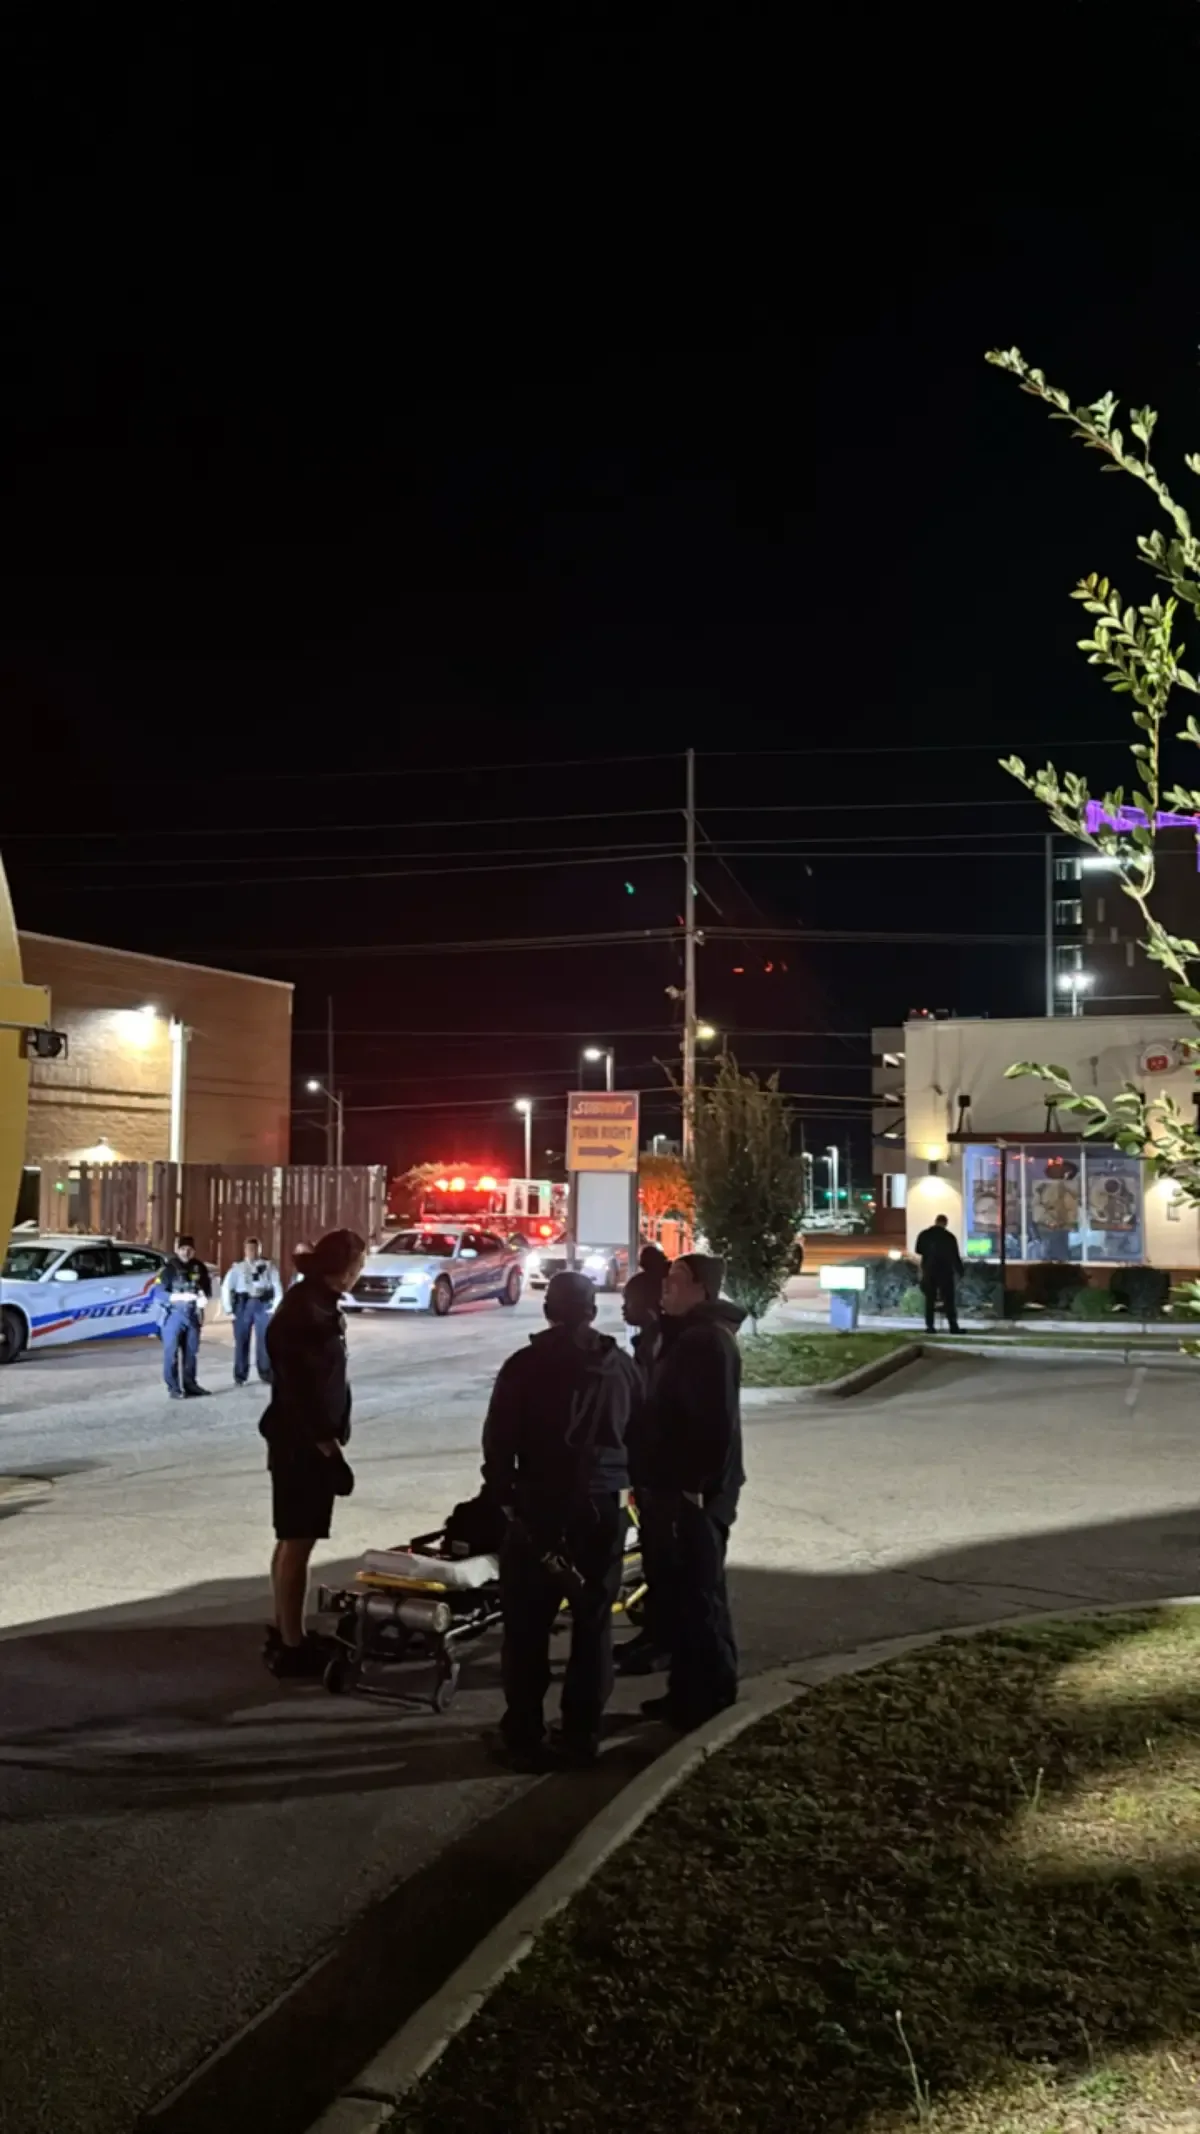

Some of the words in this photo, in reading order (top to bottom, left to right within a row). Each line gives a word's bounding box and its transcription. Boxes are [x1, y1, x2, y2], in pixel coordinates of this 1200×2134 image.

[572, 1126, 599, 1139] TURN
[601, 1126, 632, 1140] RIGHT
[73, 1303, 152, 1319] POLICE
